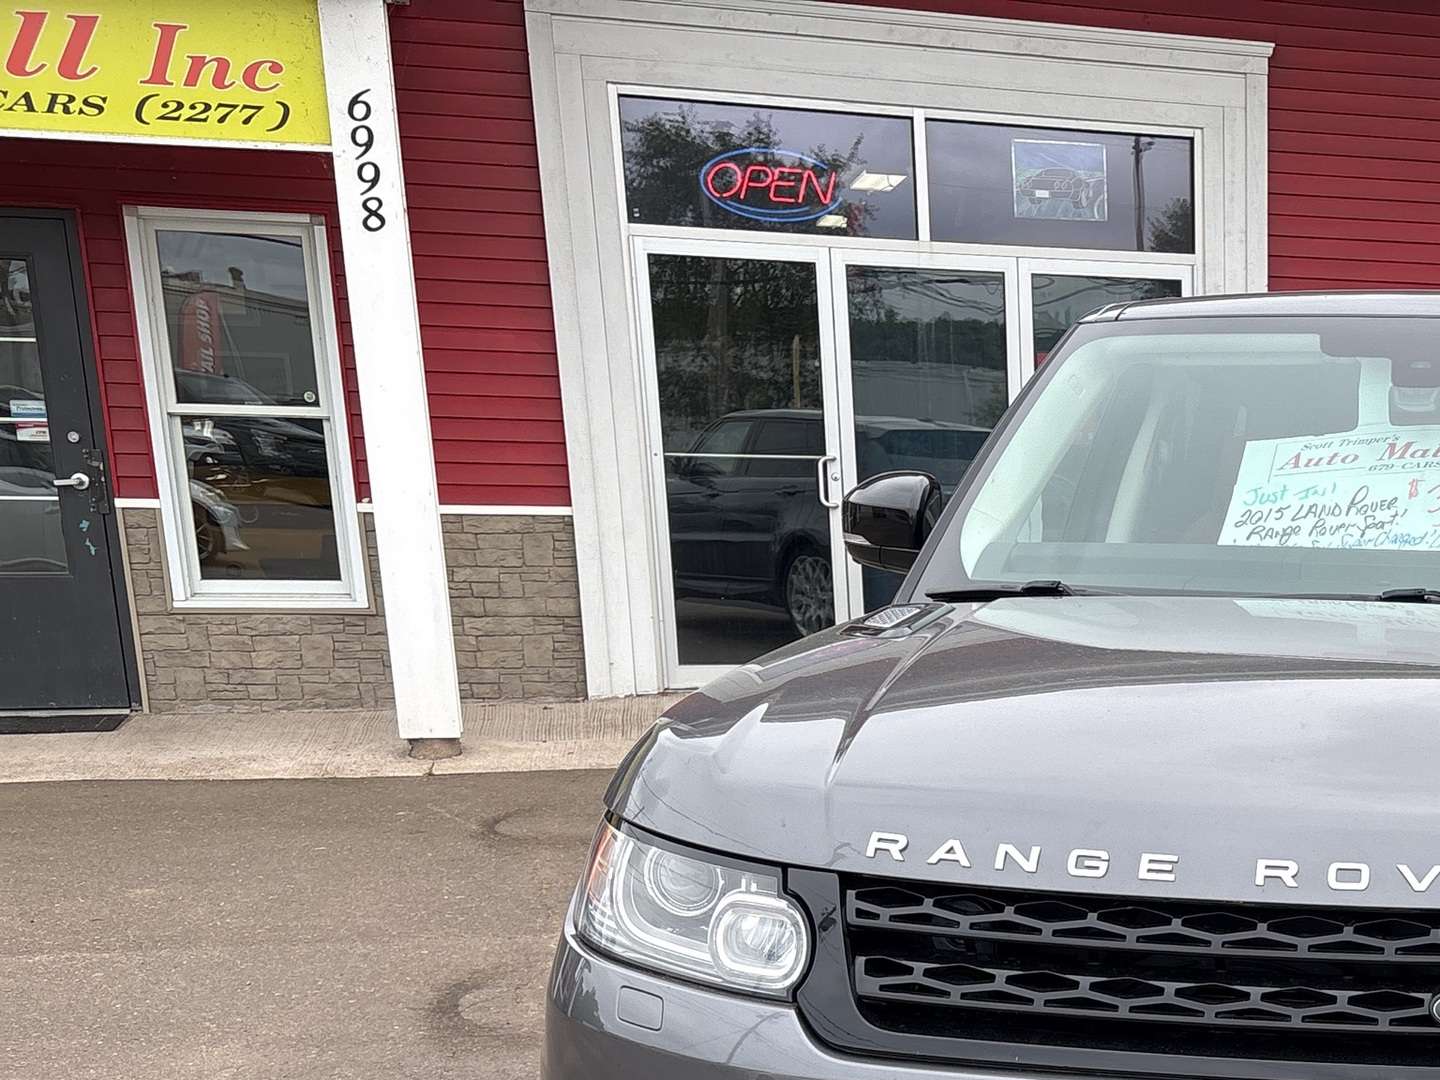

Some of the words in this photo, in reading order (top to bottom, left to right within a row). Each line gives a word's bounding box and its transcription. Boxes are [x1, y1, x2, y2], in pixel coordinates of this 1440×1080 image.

[139, 22, 285, 93] Inc
[134, 93, 291, 132] (2277)
[346, 88, 387, 233] 6998
[706, 161, 837, 206] OPEN
[1276, 451, 1360, 471] Auto
[1234, 504, 1291, 528] 2015
[1291, 502, 1343, 522] LAND
[1243, 484, 1288, 507] Just
[864, 830, 1179, 883] RANGE
